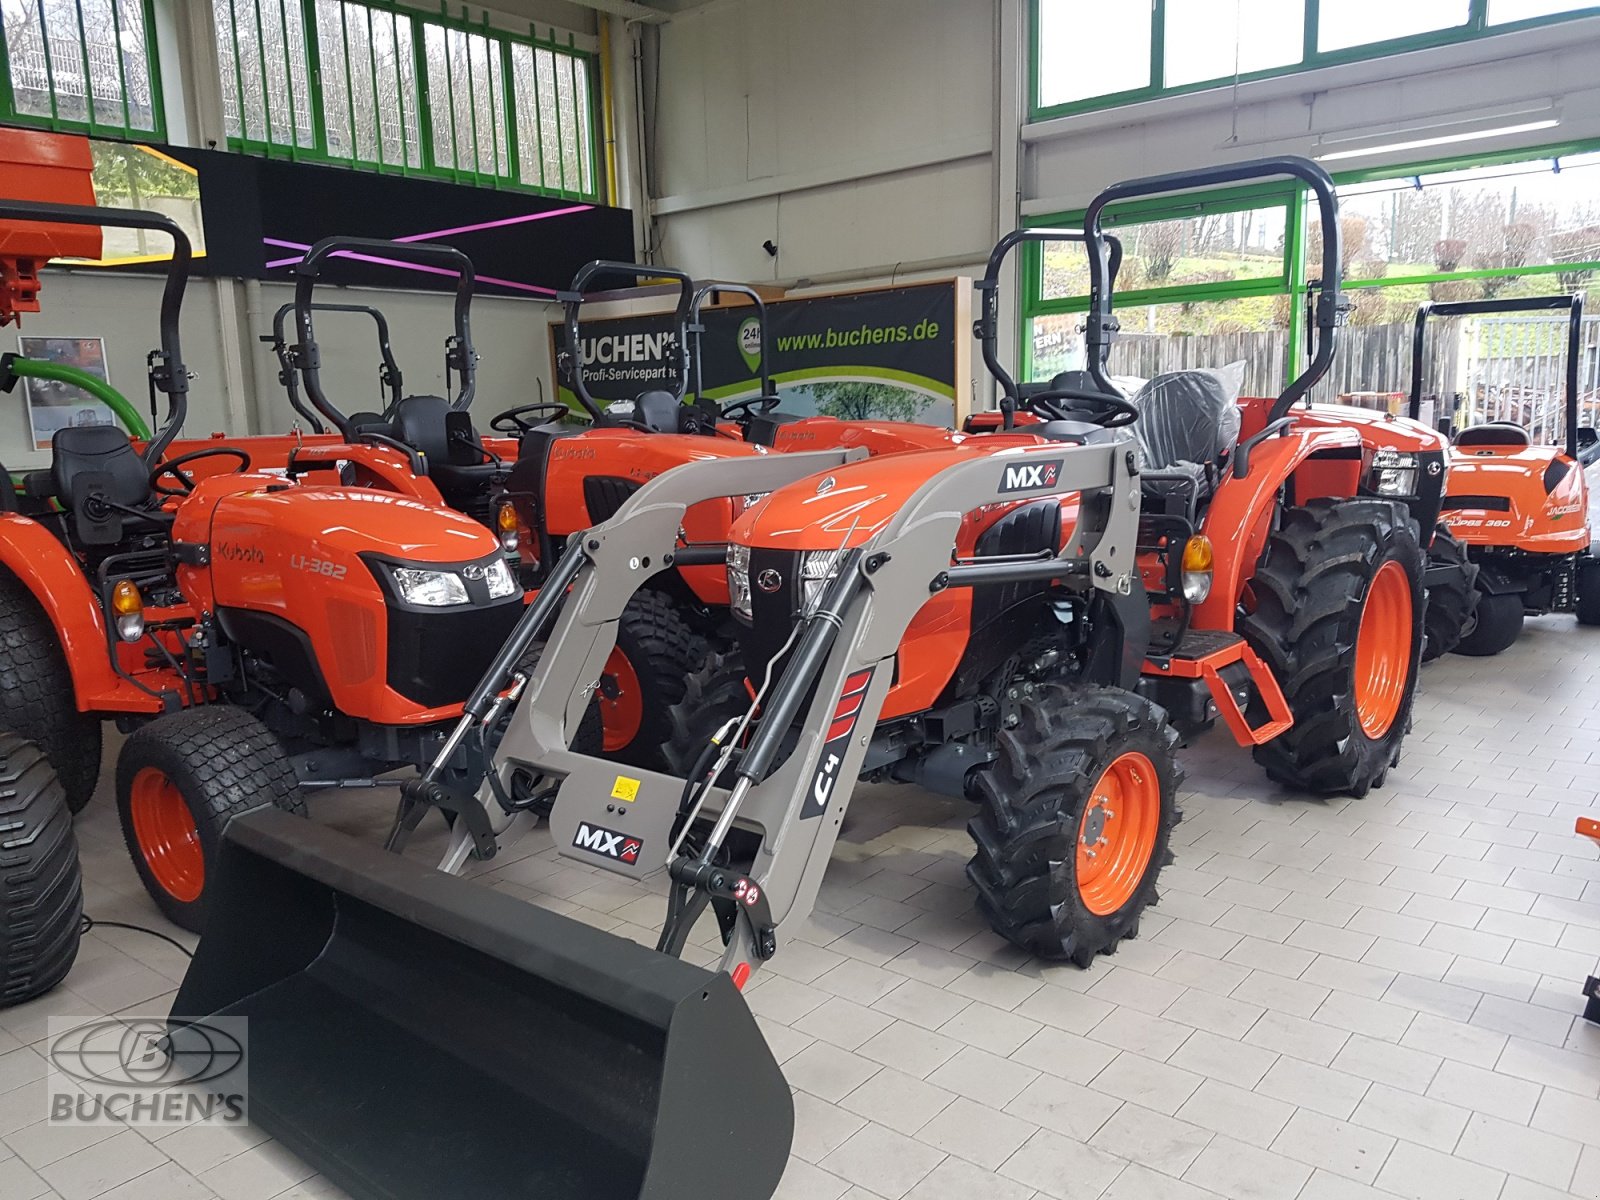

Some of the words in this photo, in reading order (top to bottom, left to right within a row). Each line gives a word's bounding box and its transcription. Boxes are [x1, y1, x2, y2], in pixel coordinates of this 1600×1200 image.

[777, 318, 940, 352] www.buchens.de
[1006, 465, 1043, 489] MX
[218, 541, 264, 564] Kubota
[290, 554, 347, 580] L1-382
[575, 824, 624, 857] MX
